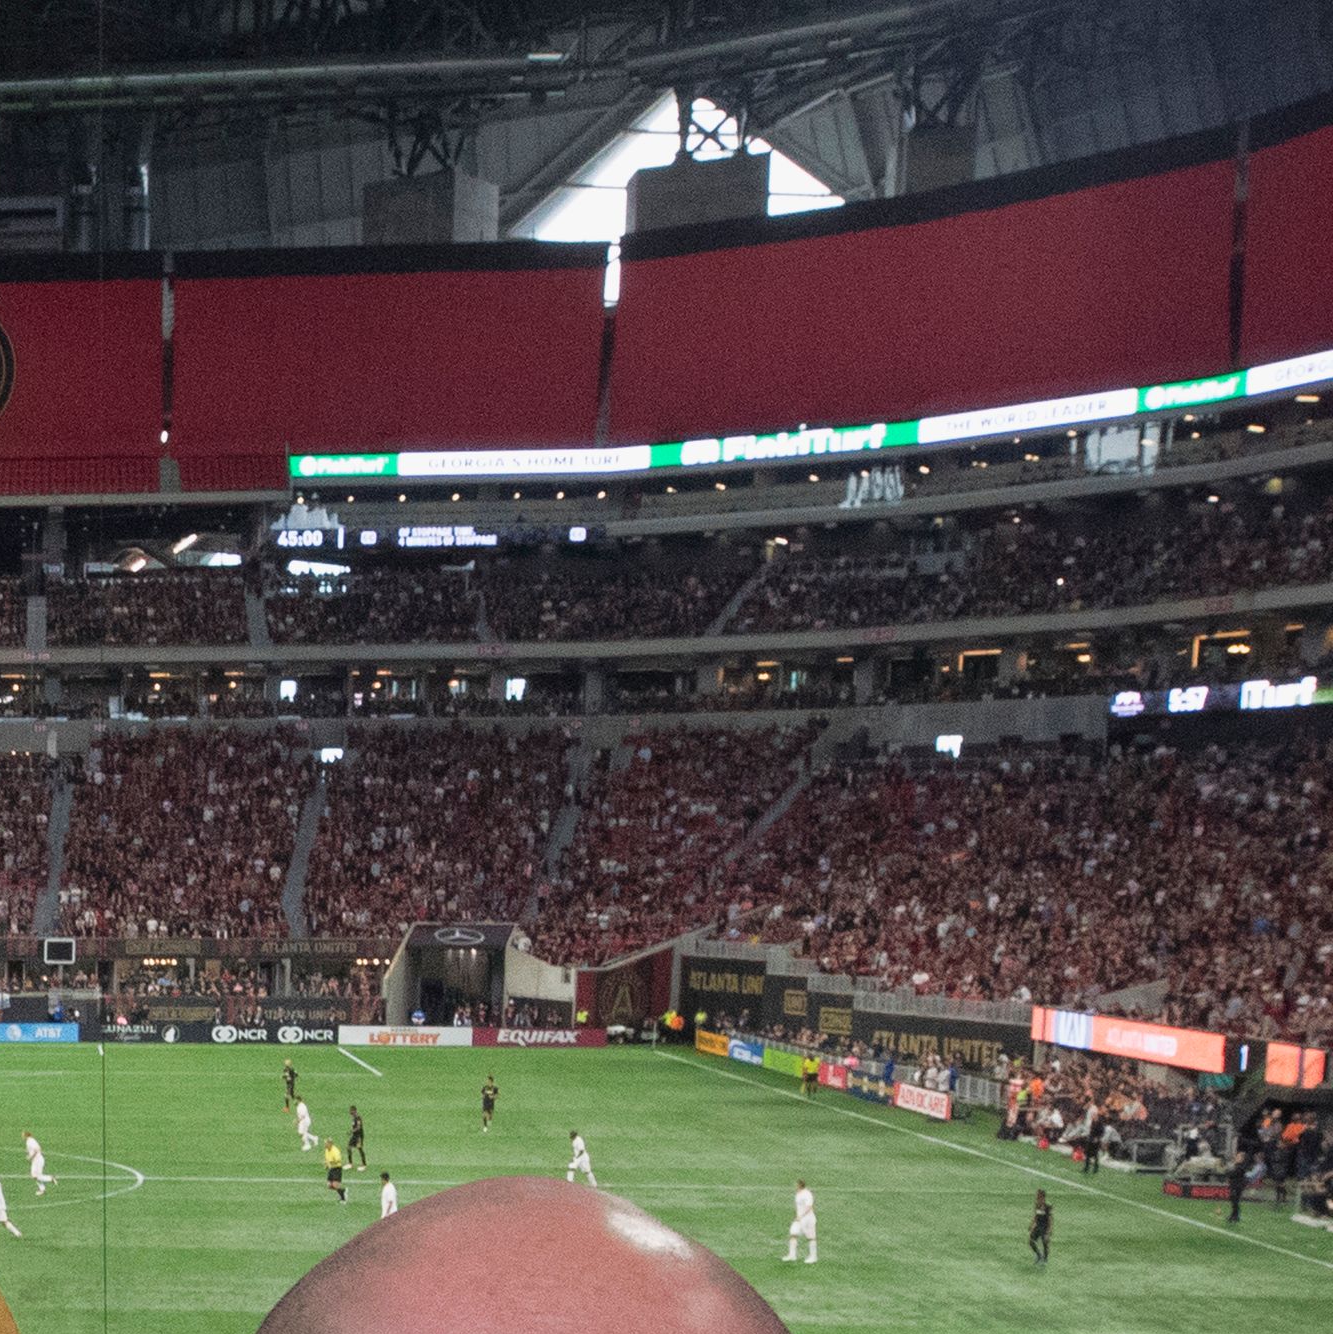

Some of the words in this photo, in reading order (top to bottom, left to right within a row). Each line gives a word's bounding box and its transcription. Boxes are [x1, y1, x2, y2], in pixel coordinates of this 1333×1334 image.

[277, 530, 324, 547] 45:00
[238, 1029, 267, 1041] NCR
[304, 1029, 333, 1041] NCR
[497, 1029, 579, 1046] EQUIFAX
